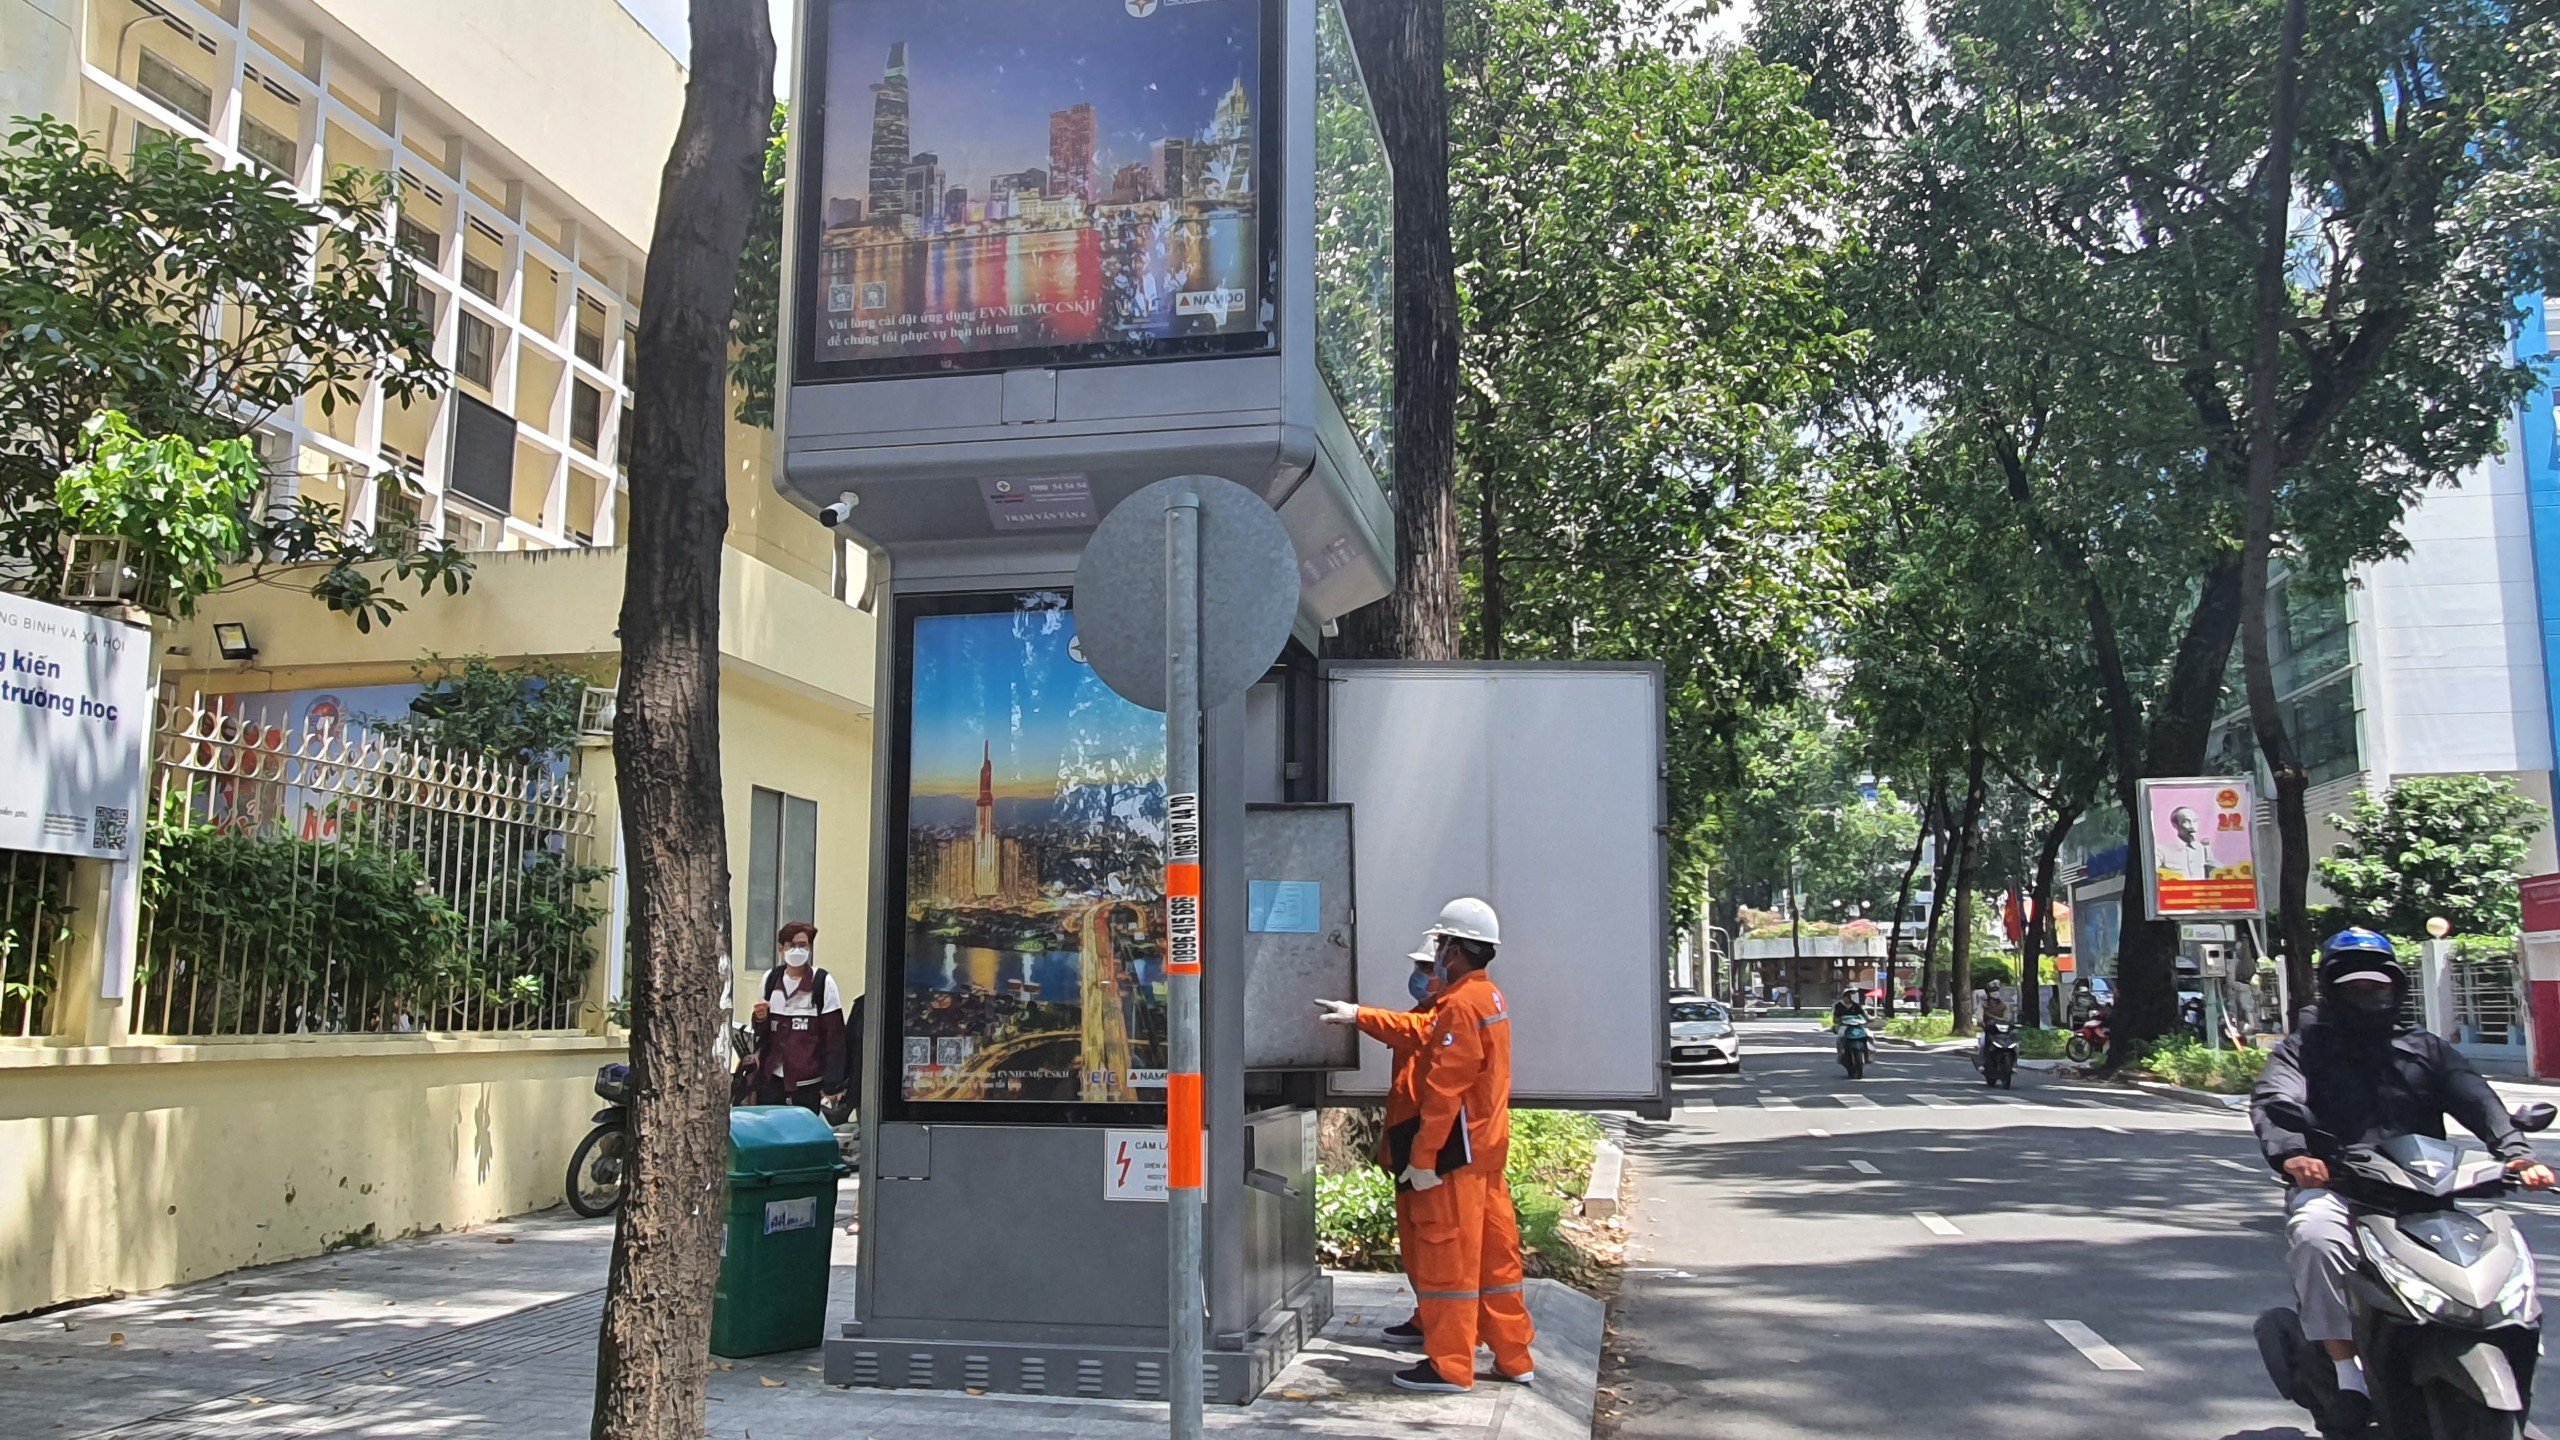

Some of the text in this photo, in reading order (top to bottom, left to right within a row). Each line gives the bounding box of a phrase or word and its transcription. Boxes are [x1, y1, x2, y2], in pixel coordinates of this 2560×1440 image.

[12, 649, 61, 679] kiến
[2, 679, 119, 723] trường học
